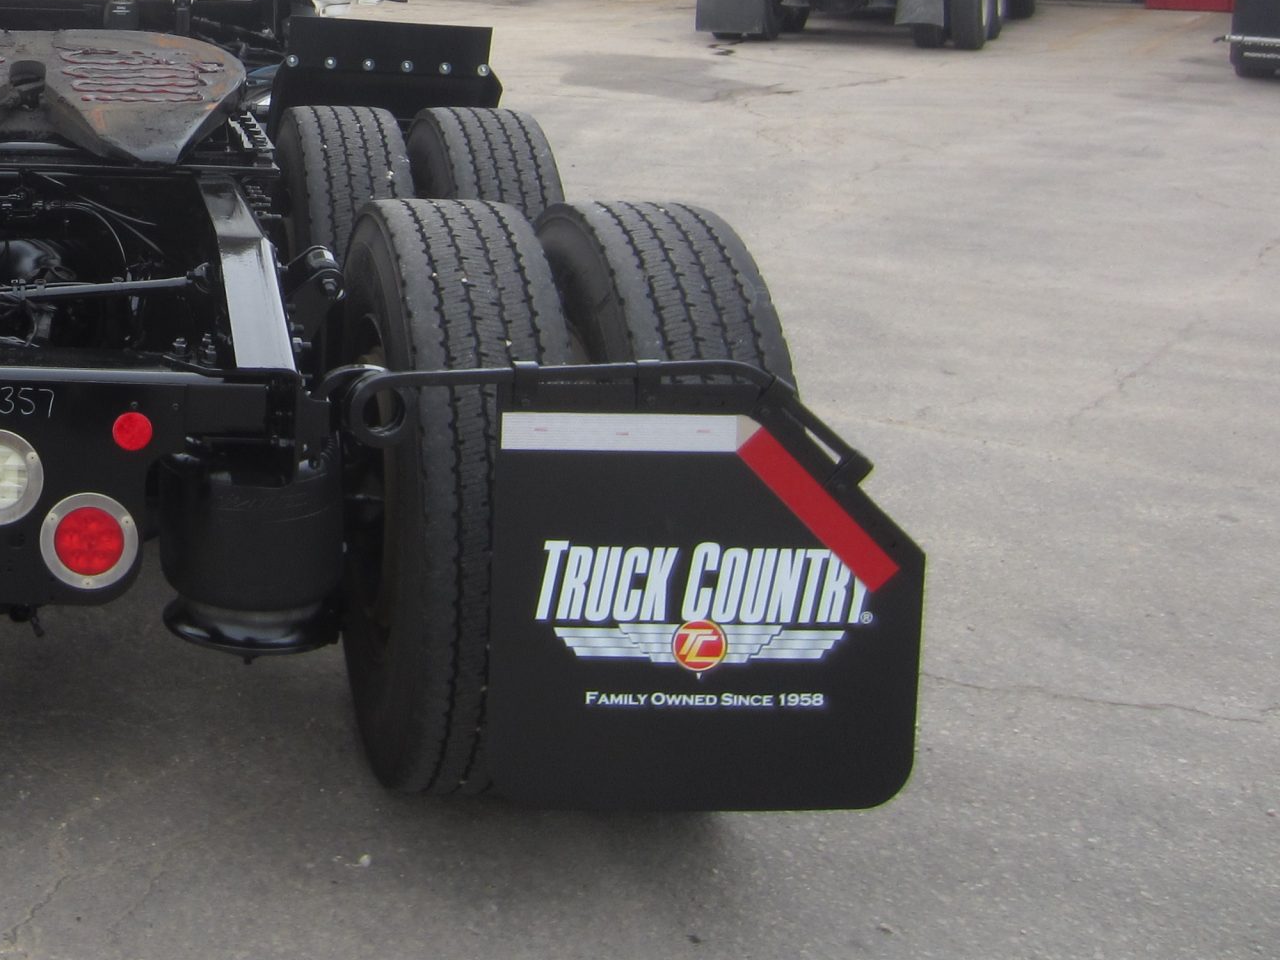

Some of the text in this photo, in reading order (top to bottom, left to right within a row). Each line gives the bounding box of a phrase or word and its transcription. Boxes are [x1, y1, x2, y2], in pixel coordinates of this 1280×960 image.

[534, 540, 680, 622] TRUCK
[585, 691, 824, 707] FAMILY OWNED SINCE 1958
